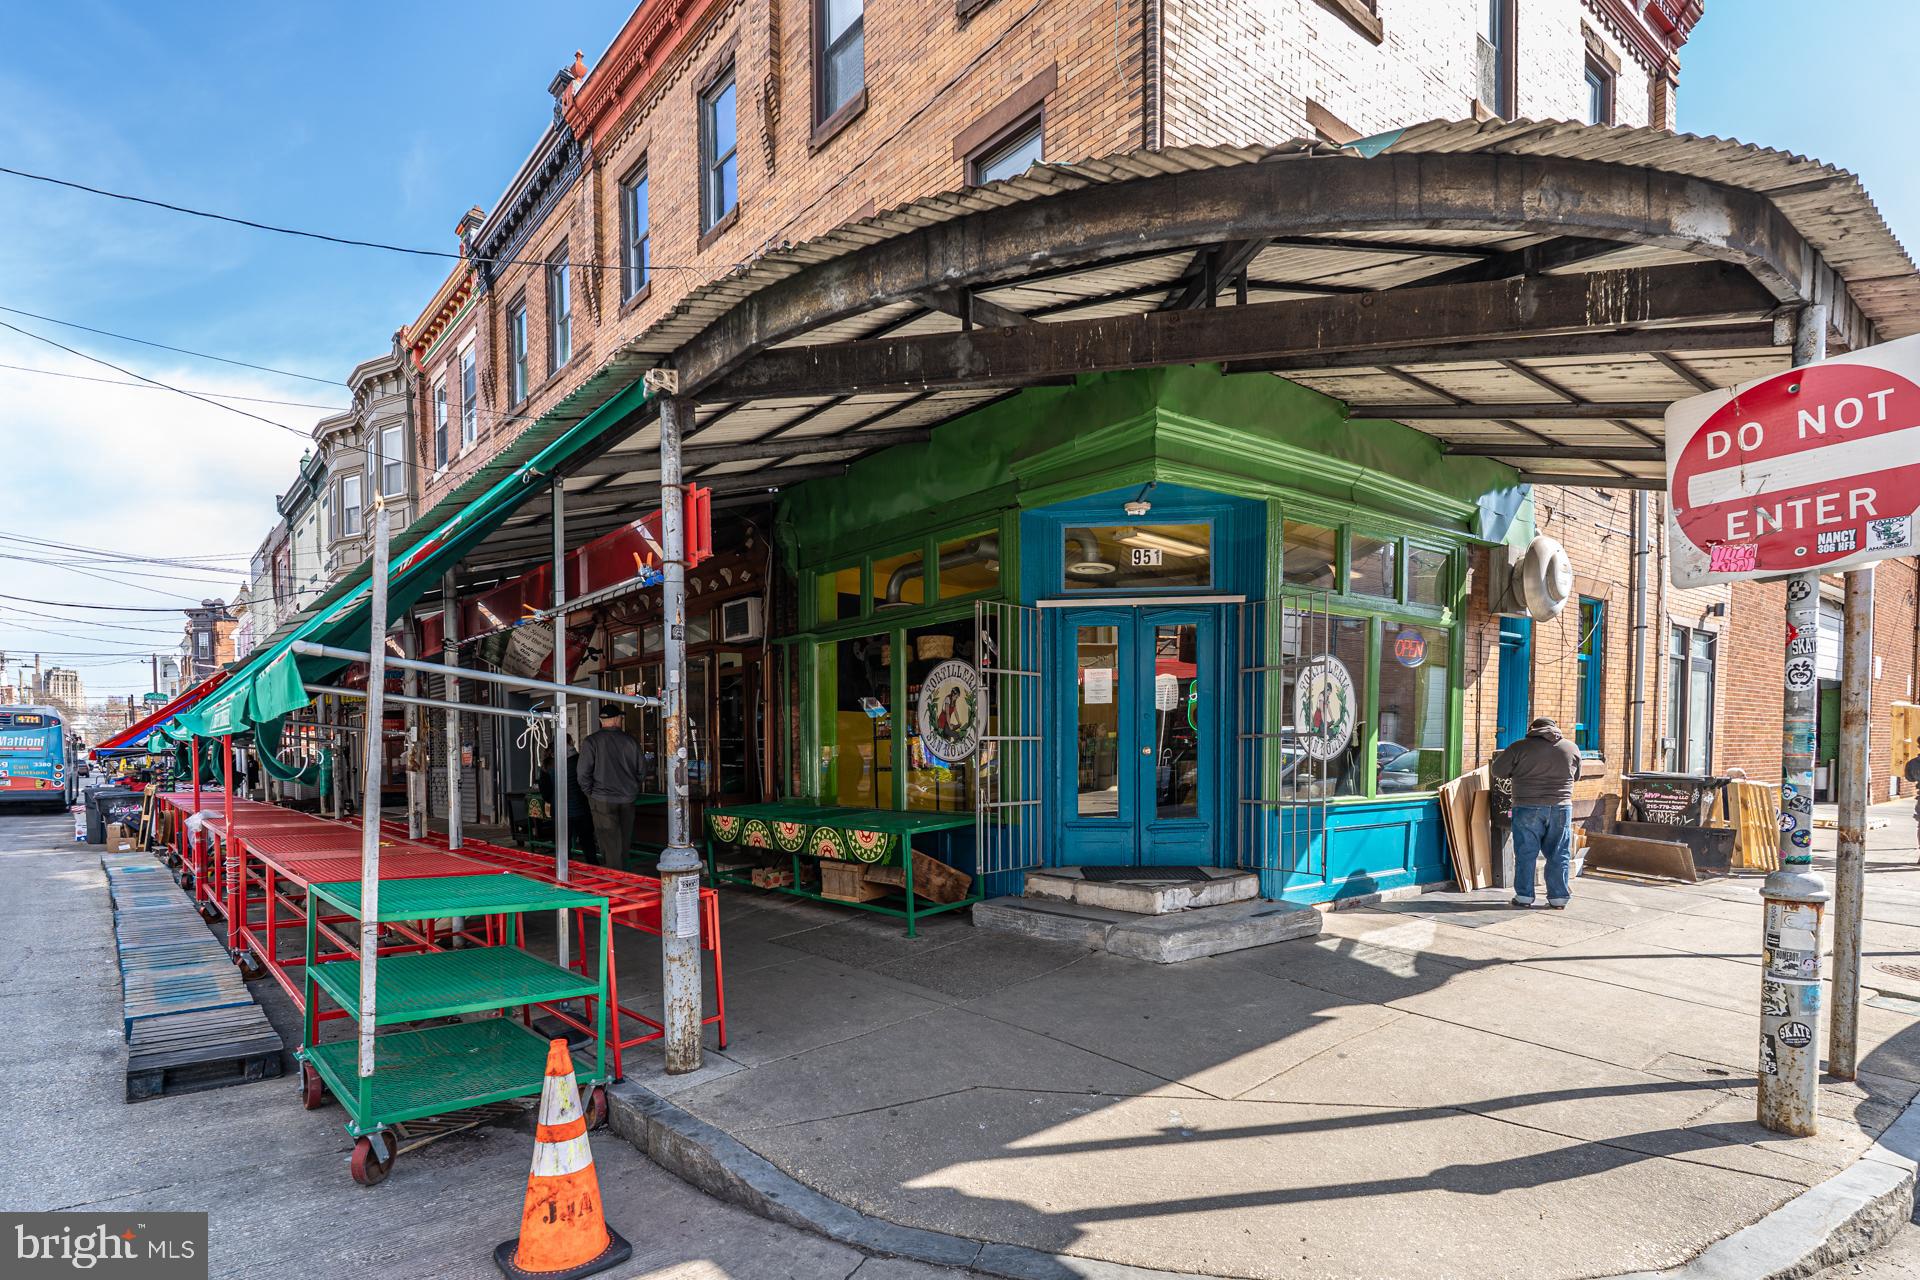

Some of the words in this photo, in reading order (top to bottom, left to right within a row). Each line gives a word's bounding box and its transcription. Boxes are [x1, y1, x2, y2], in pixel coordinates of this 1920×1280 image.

[1706, 421, 1764, 460] DO
[1797, 388, 1895, 439] NOT
[1727, 487, 1878, 541] ENTER
[1817, 529, 1856, 545] NANCY
[1817, 543, 1836, 554] 306
[1134, 549, 1160, 565] 951
[1395, 639, 1424, 659] OPEN
[17, 715, 39, 724] 47M
[926, 731, 944, 754] SAN
[1644, 792, 1661, 800] MVP
[1779, 1023, 1811, 1039] SKATE
